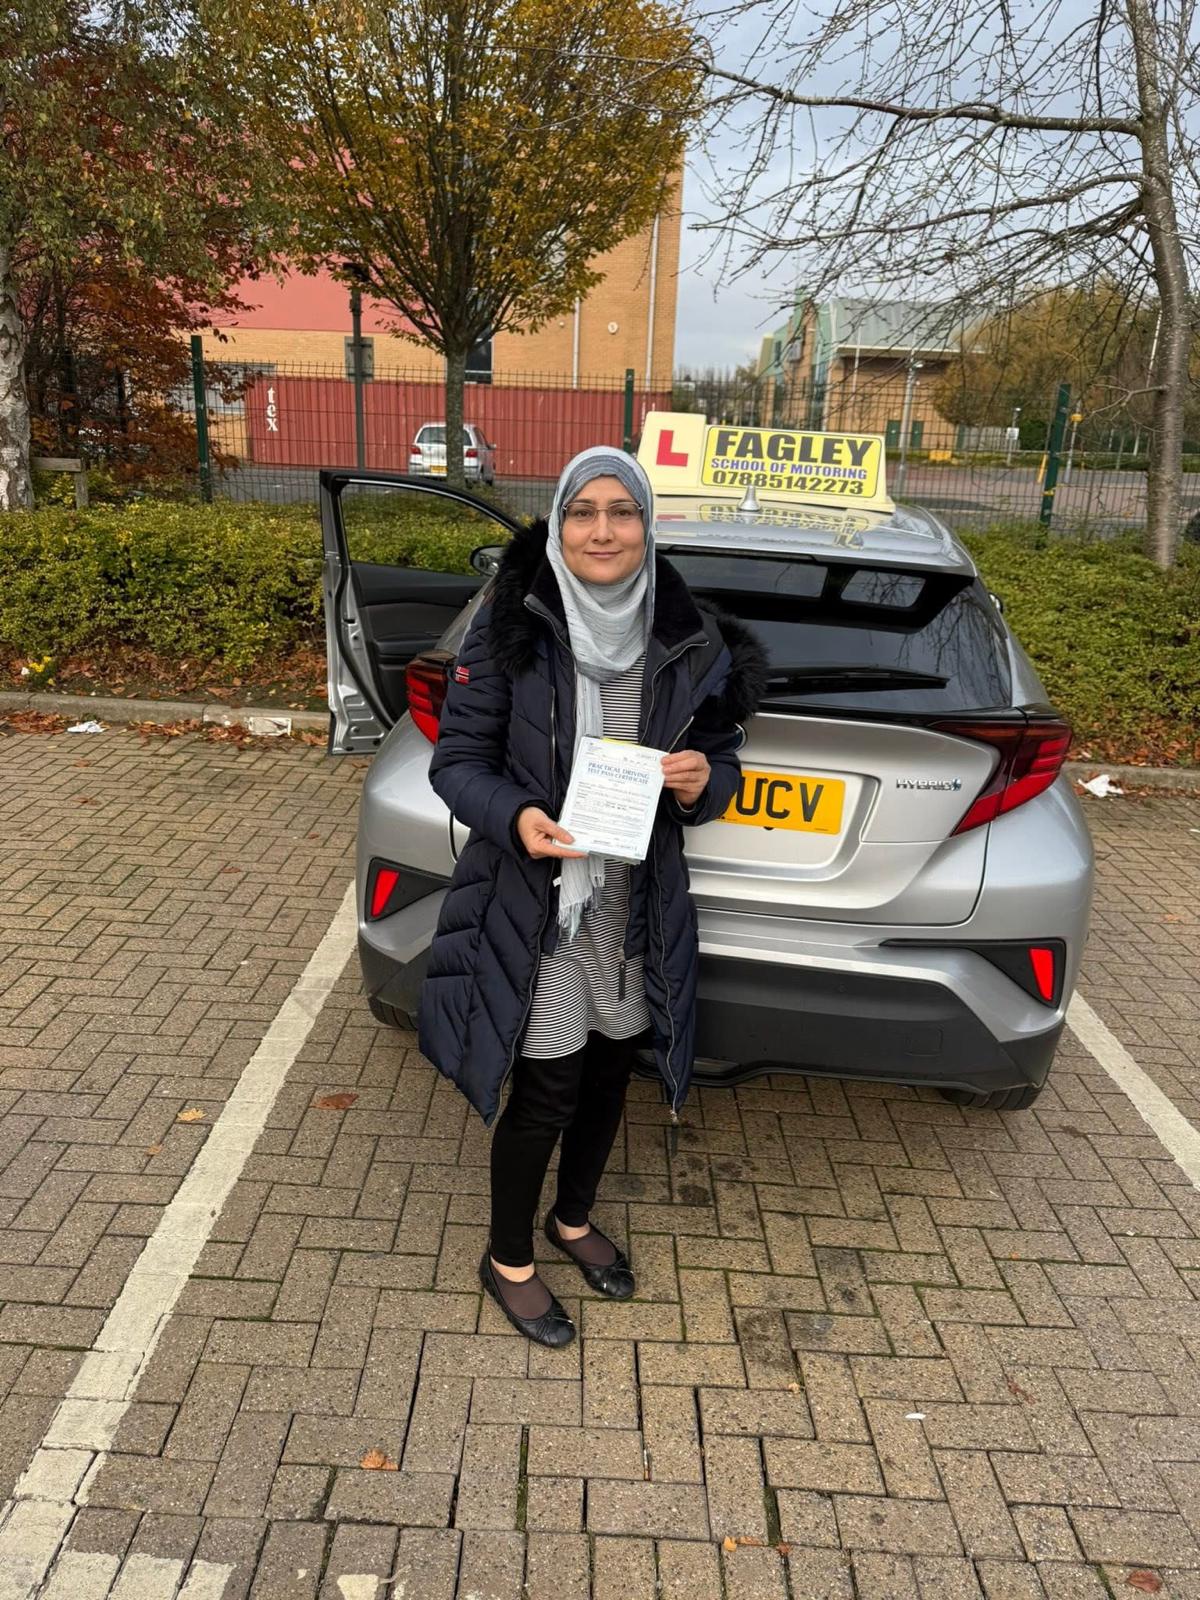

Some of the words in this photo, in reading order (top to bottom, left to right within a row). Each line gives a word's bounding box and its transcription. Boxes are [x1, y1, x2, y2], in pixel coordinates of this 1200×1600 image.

[656, 430, 689, 467] L
[715, 430, 874, 467] FAGLEY
[711, 458, 766, 472] SCHOOL
[770, 463, 787, 473] OF
[791, 464, 867, 480] MOTORING
[712, 471, 864, 495] 07885142273
[588, 762, 621, 773] PRACTICAL
[622, 768, 649, 779] DRIVING
[588, 767, 600, 775] TEST
[614, 773, 649, 785] CERTIFICATE
[735, 776, 824, 822] UCV
